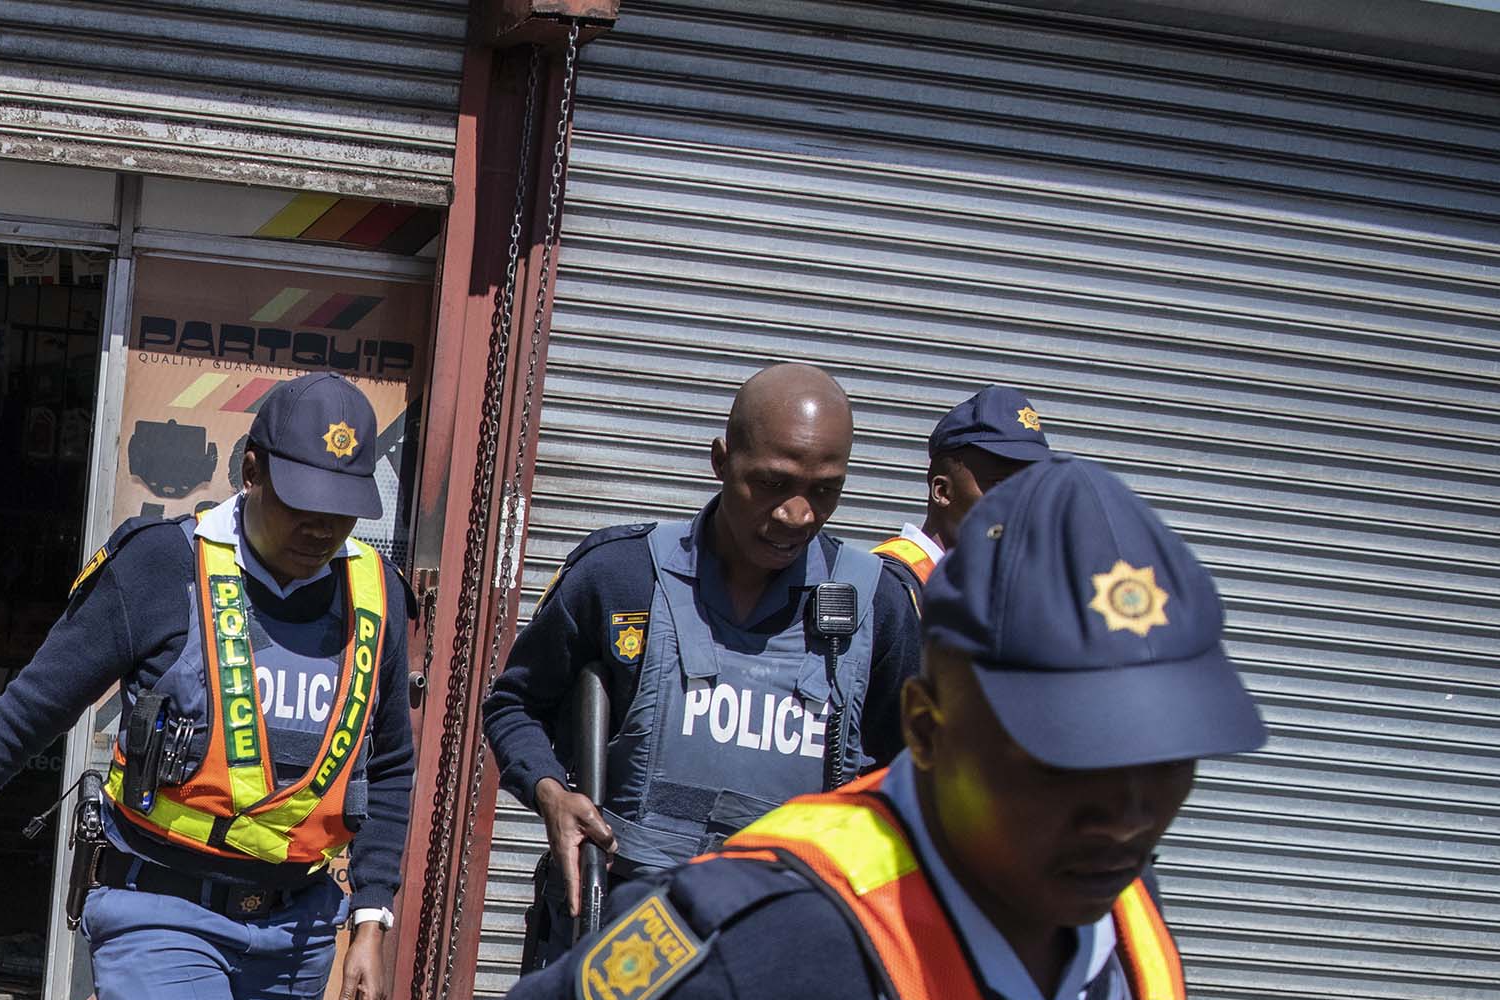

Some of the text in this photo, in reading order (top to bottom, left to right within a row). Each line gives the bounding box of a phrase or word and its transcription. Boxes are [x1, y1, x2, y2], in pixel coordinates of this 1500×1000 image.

[138, 352, 204, 368] QUALITY
[216, 581, 257, 759] POLICE
[255, 665, 339, 723] OLIC
[315, 616, 375, 789] POLICE
[682, 683, 829, 759] POLICE
[638, 907, 687, 966] POLICE
